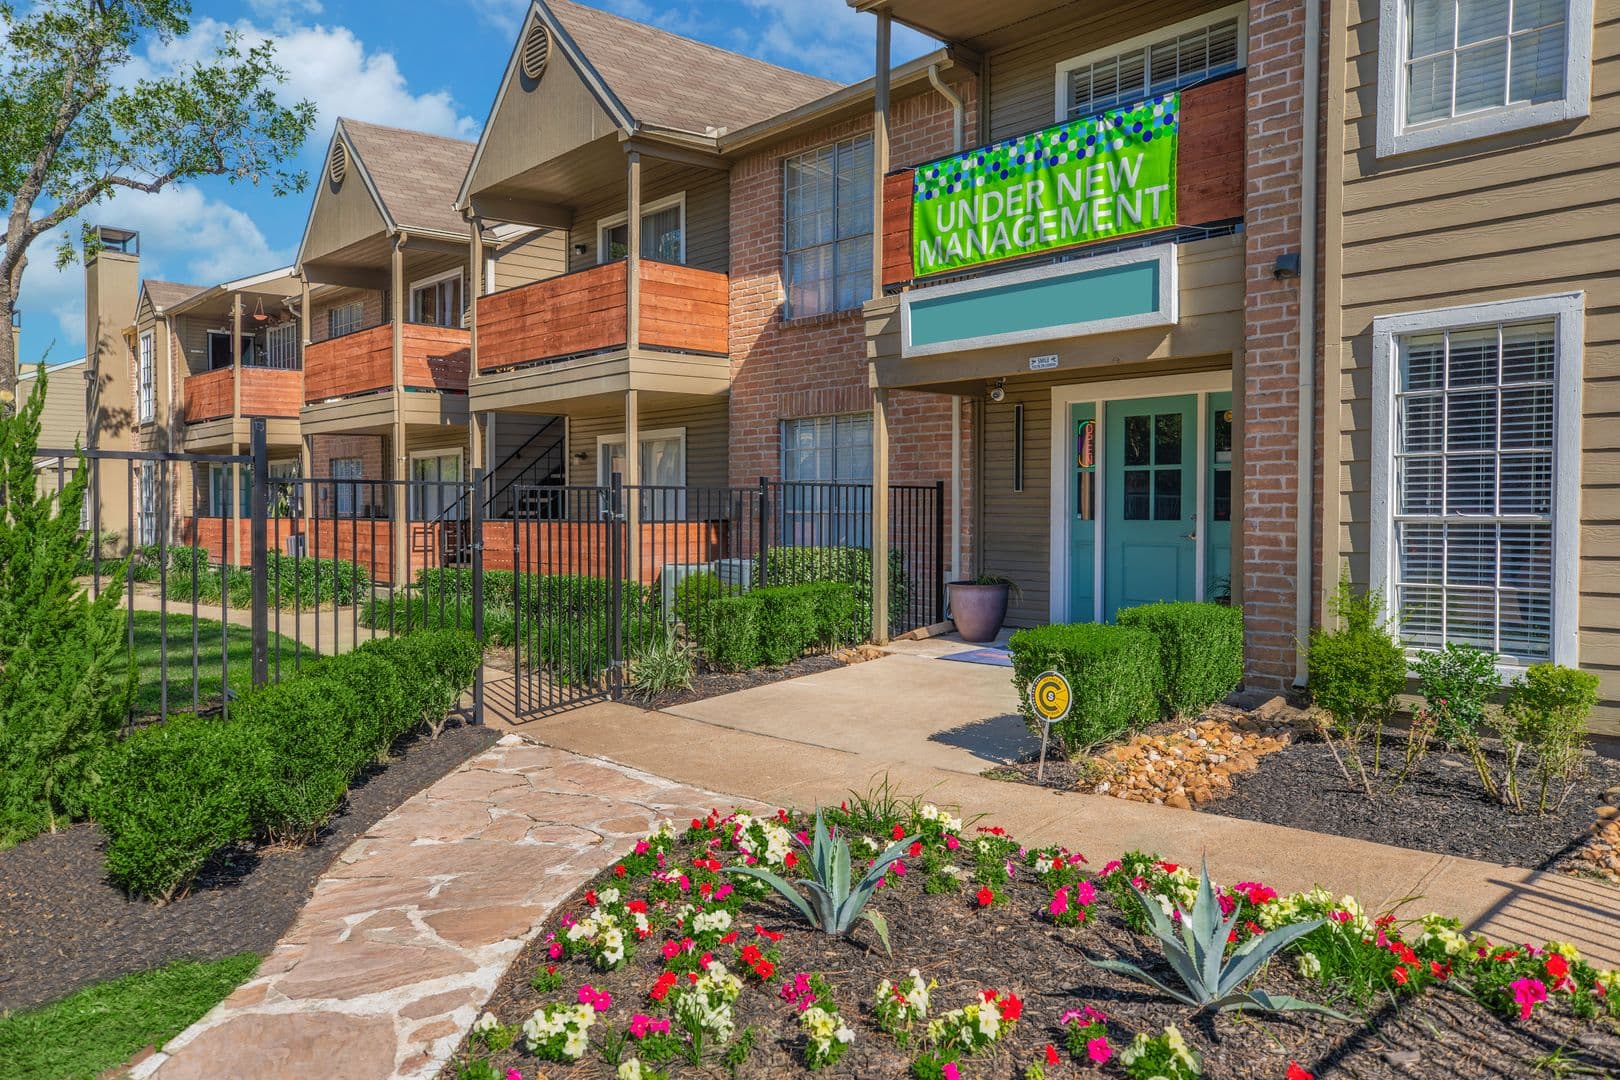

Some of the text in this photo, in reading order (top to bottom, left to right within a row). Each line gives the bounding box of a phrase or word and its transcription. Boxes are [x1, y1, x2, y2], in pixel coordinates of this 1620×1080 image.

[919, 184, 1169, 269] MANAGEMENT
[936, 152, 1145, 233] UNDER NEW
